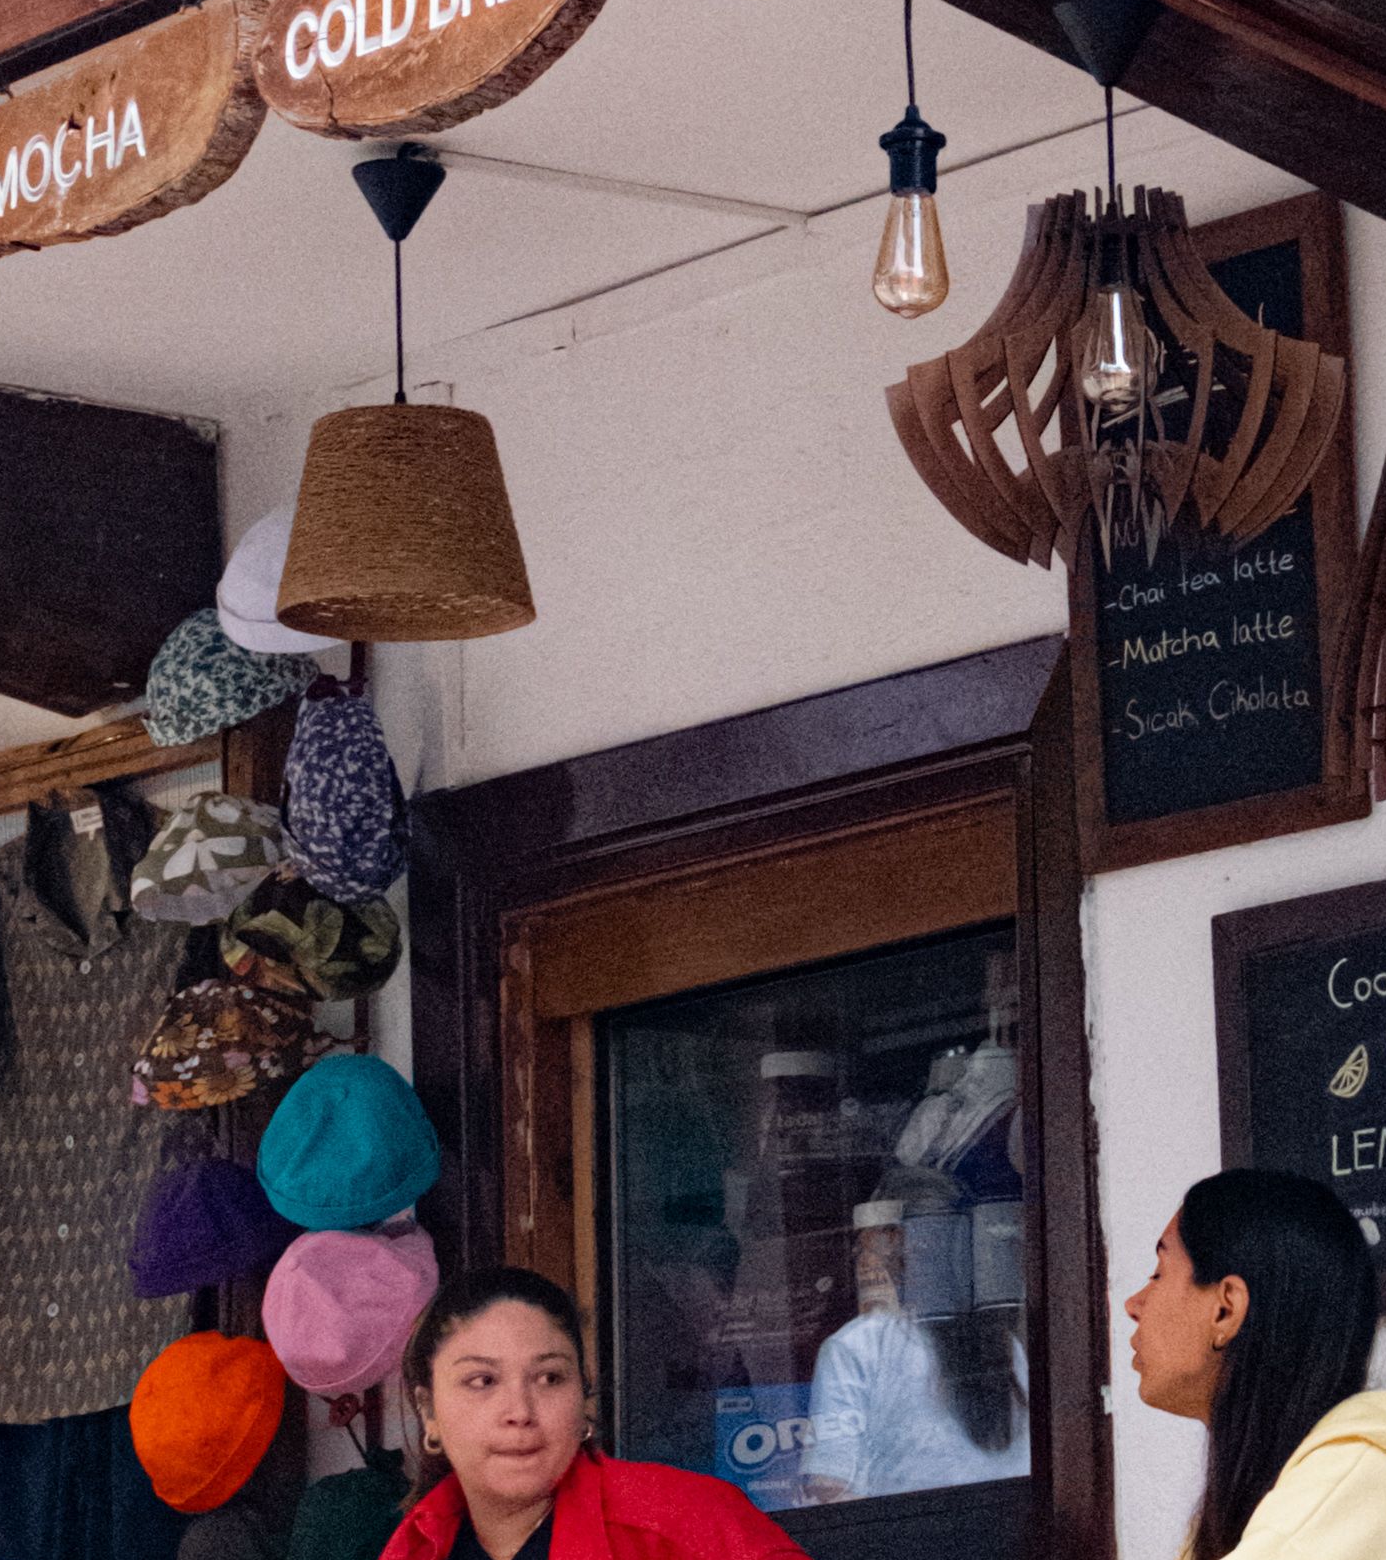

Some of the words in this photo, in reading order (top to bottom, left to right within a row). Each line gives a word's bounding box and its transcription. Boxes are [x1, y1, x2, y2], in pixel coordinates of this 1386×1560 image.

[1179, 568, 1221, 596] tea
[1232, 549, 1296, 580] latte
[1231, 611, 1296, 646] latte
[731, 1409, 867, 1466] OREO
